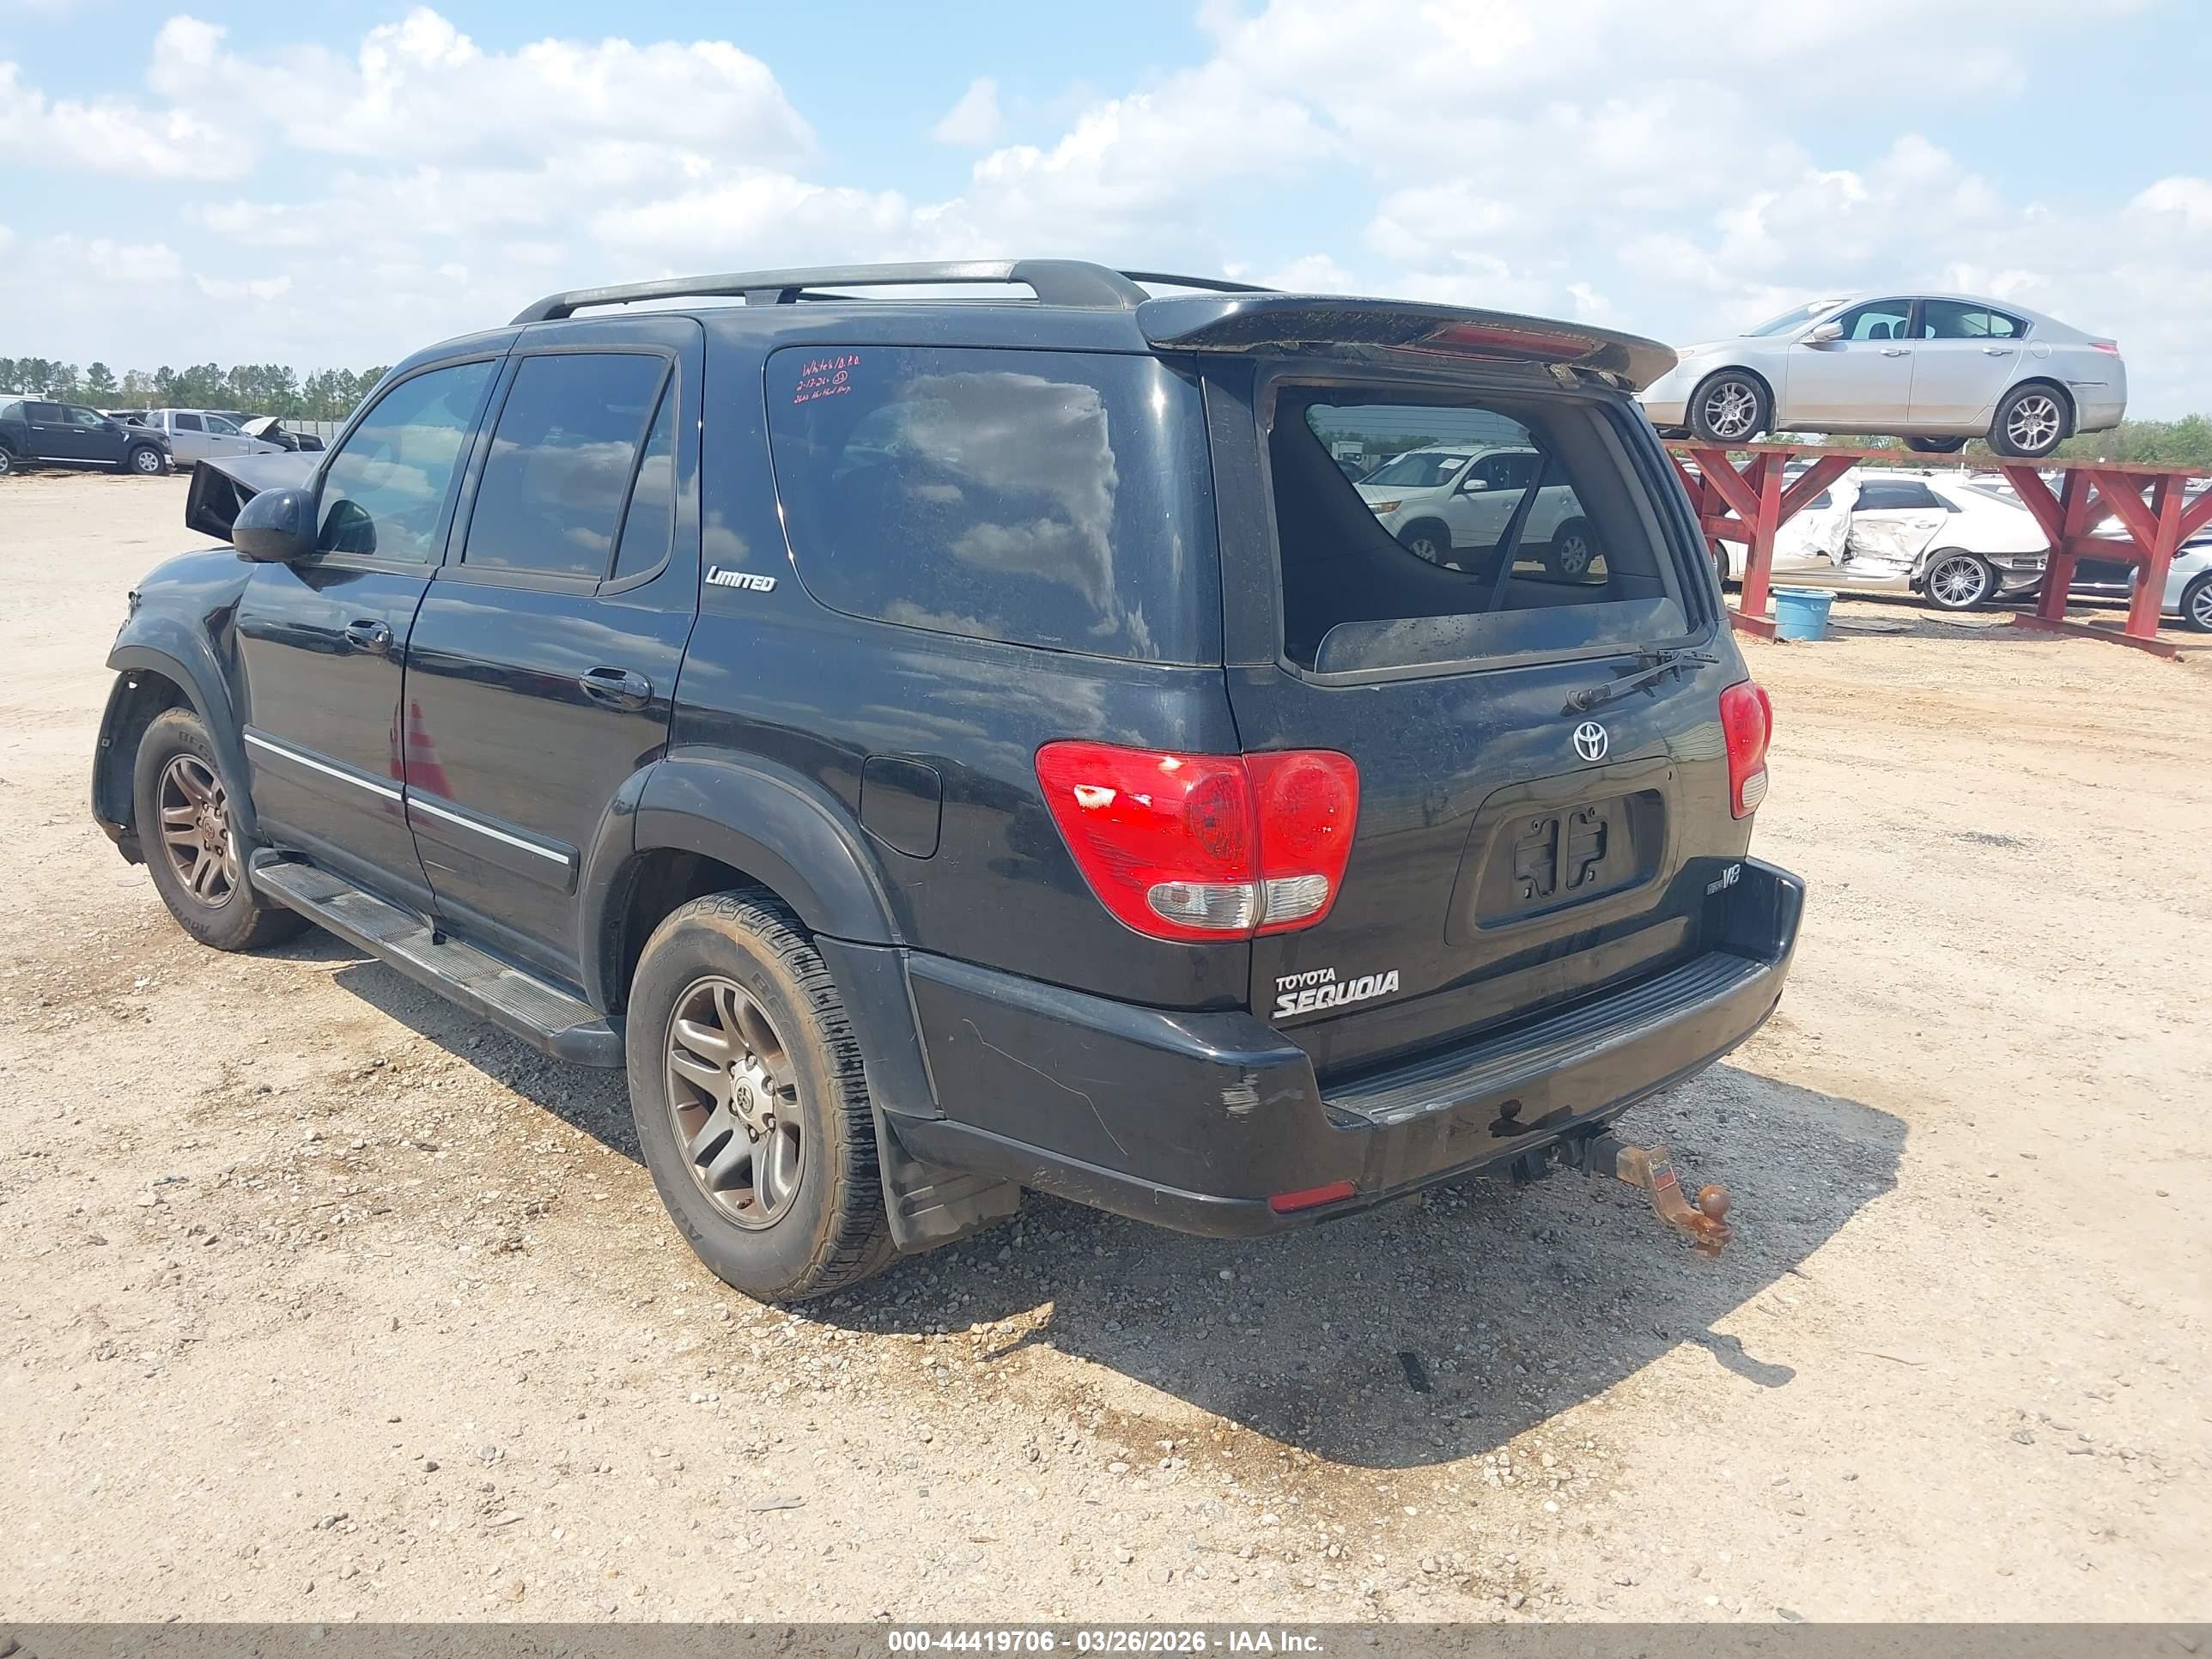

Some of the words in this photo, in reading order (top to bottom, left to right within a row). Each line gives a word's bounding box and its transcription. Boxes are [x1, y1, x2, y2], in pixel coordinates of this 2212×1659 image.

[705, 565, 777, 592] LIMITED
[1723, 863, 1741, 889] V8
[1275, 967, 1336, 992] TOYOTA
[1272, 969, 1400, 1019] SEQUOIA
